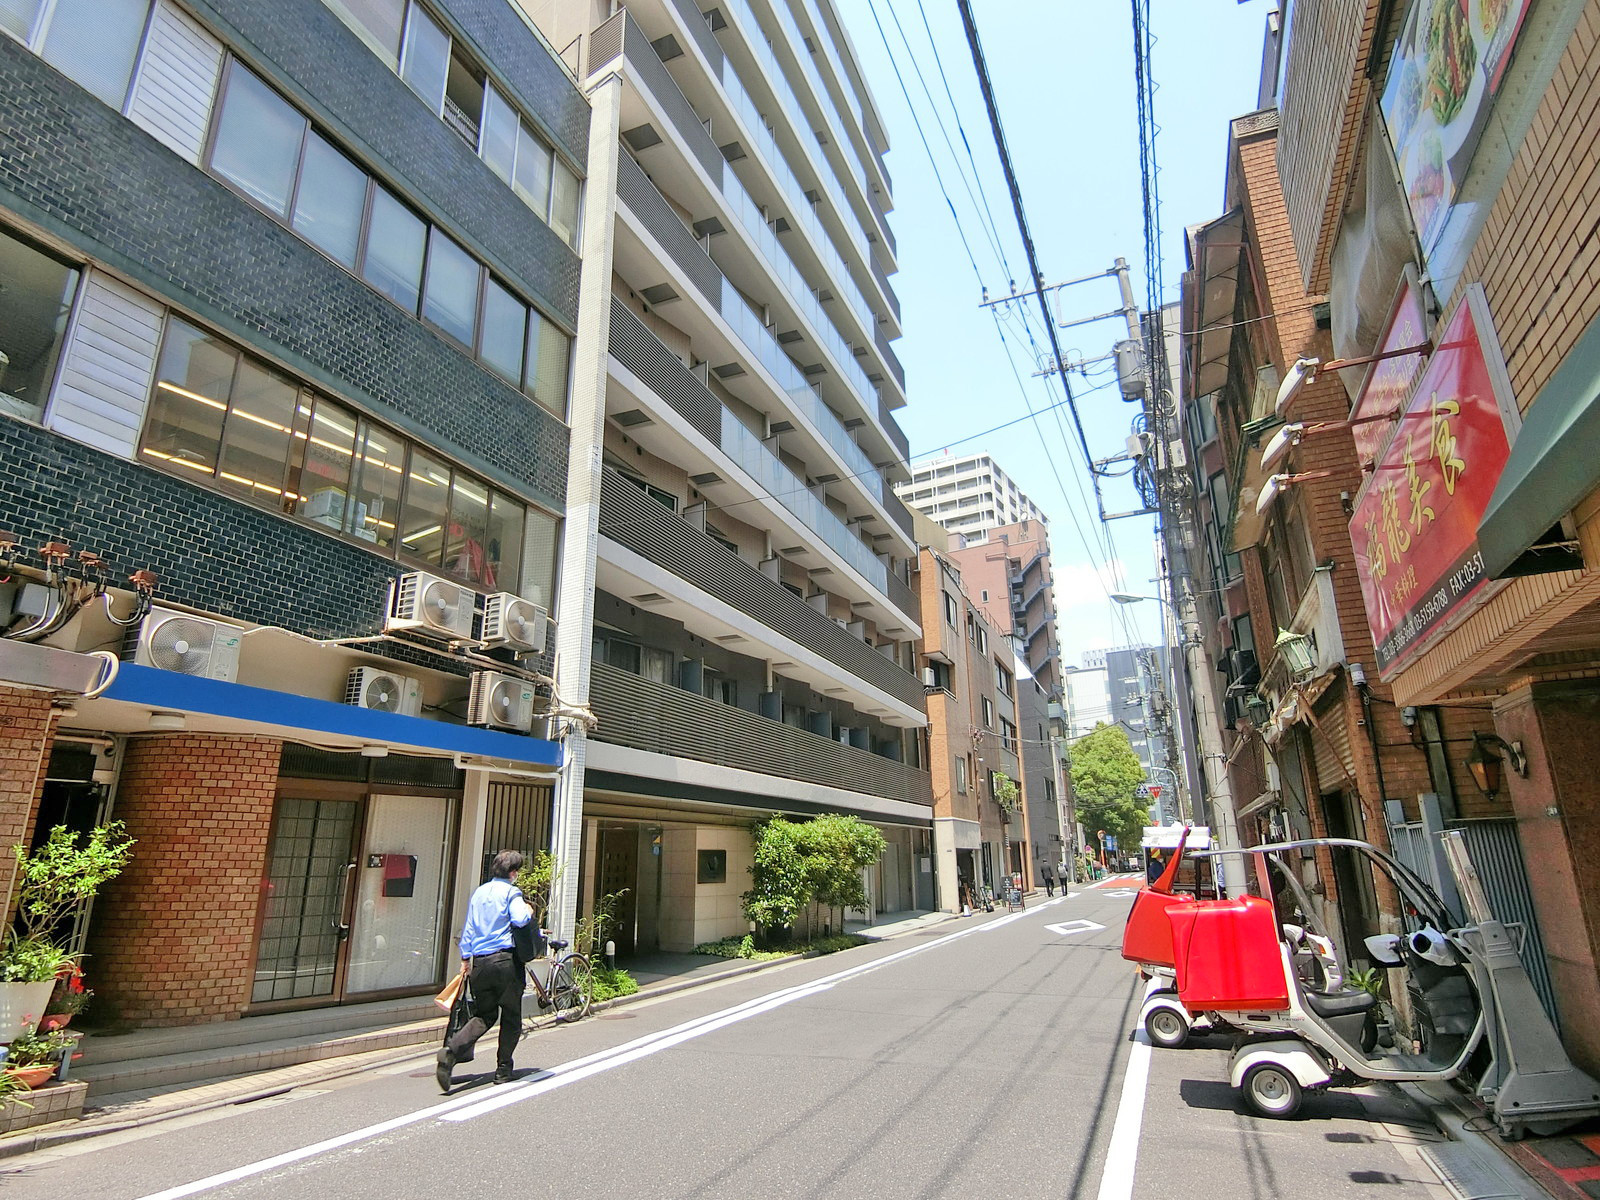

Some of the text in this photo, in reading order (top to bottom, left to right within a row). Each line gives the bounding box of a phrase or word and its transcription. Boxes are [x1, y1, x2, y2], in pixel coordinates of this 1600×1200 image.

[1390, 564, 1419, 607] 中華料理
[1413, 587, 1449, 632] 03-5159-6788
